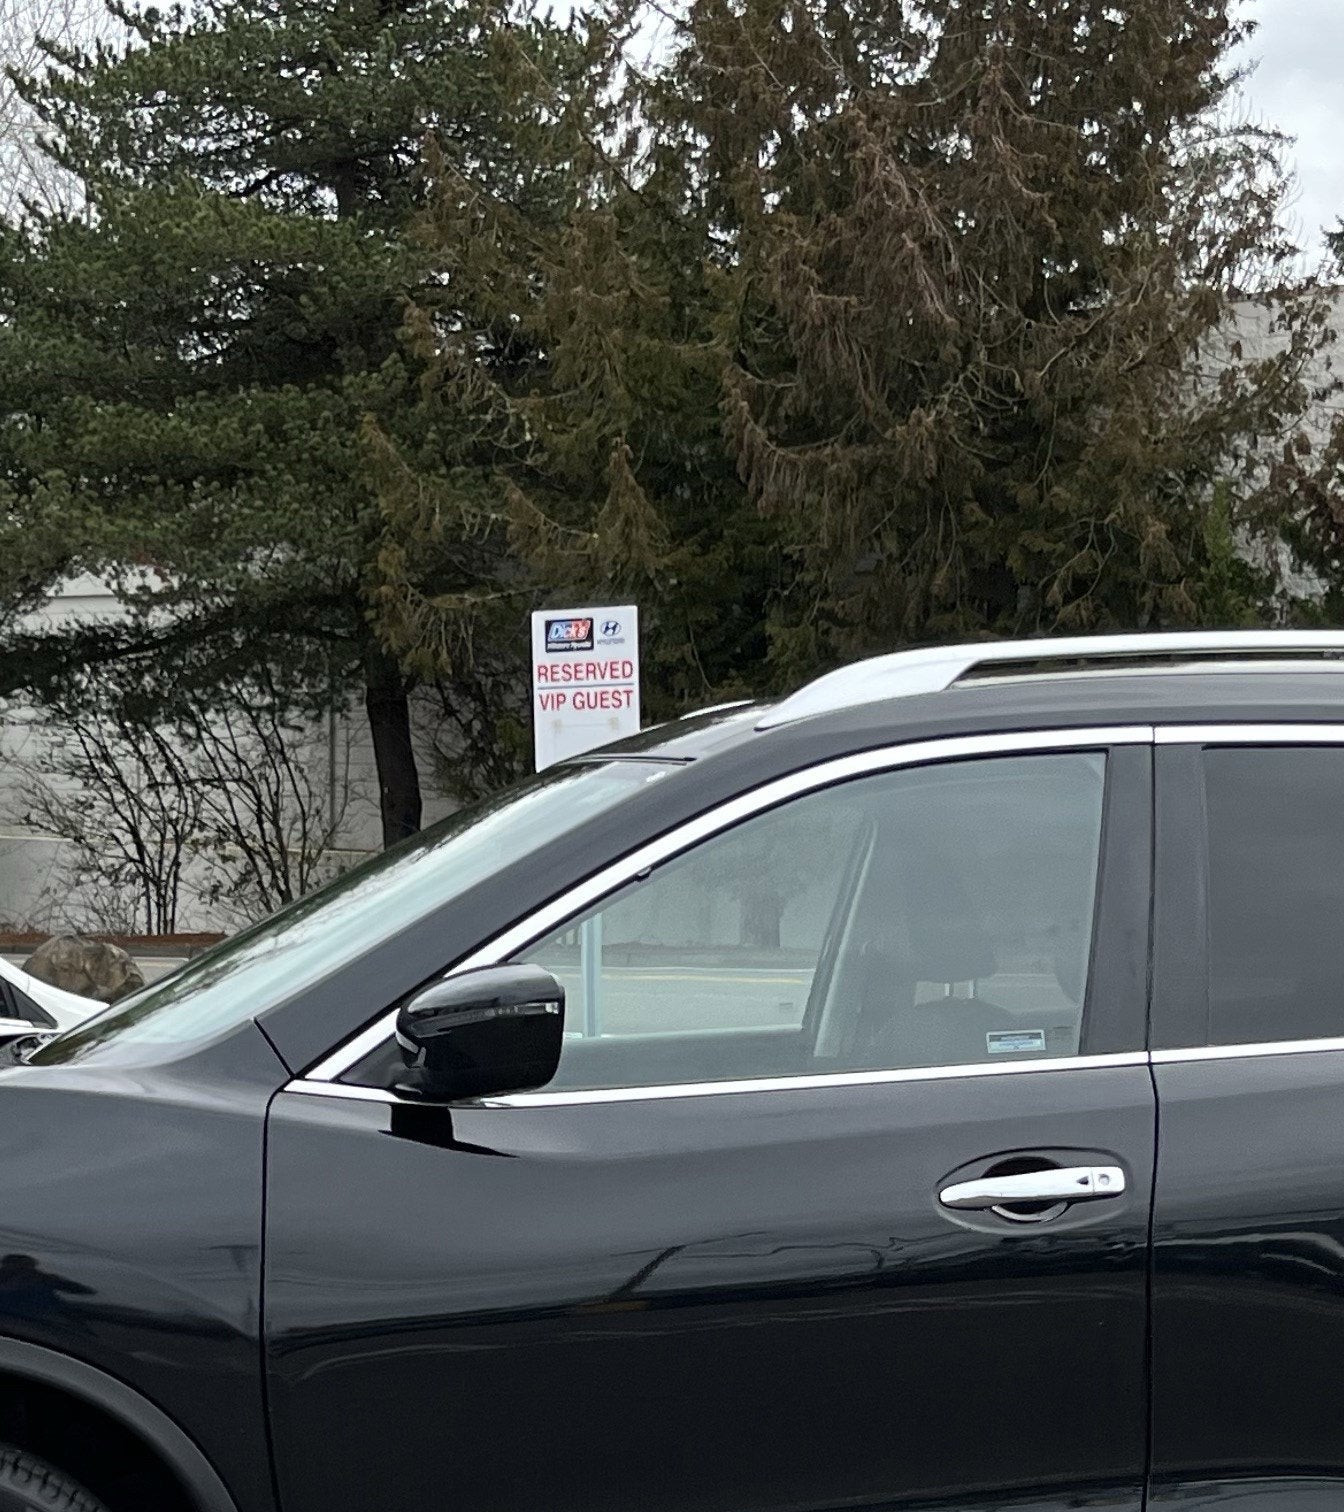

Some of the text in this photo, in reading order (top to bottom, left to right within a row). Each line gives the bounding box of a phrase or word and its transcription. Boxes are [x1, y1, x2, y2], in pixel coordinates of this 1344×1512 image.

[537, 660, 634, 682] RESERVED
[538, 689, 634, 711] VIP GUEST
